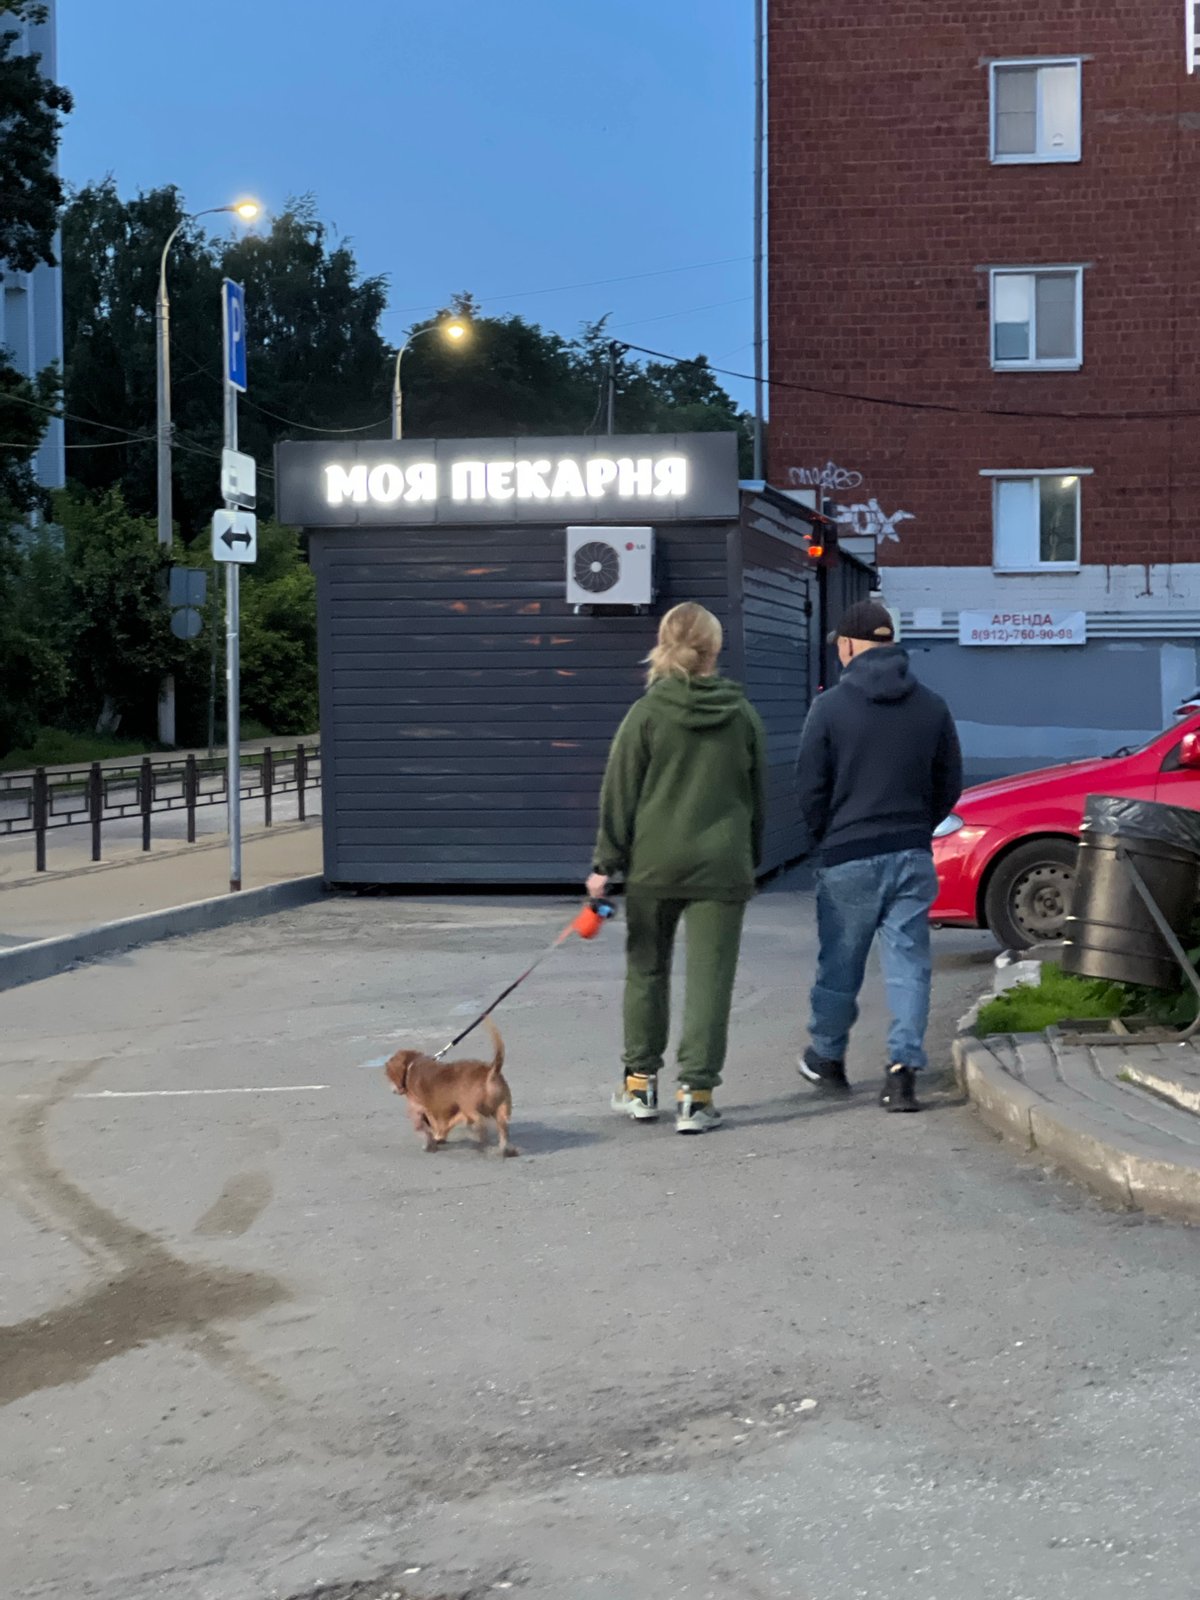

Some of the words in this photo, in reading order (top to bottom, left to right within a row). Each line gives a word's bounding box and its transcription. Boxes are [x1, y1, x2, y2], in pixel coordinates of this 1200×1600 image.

[231, 296, 241, 372] P
[324, 462, 437, 503] МОЯ
[451, 457, 687, 500] ПЕКАРНЯ
[991, 614, 1053, 626] АРЕНДА
